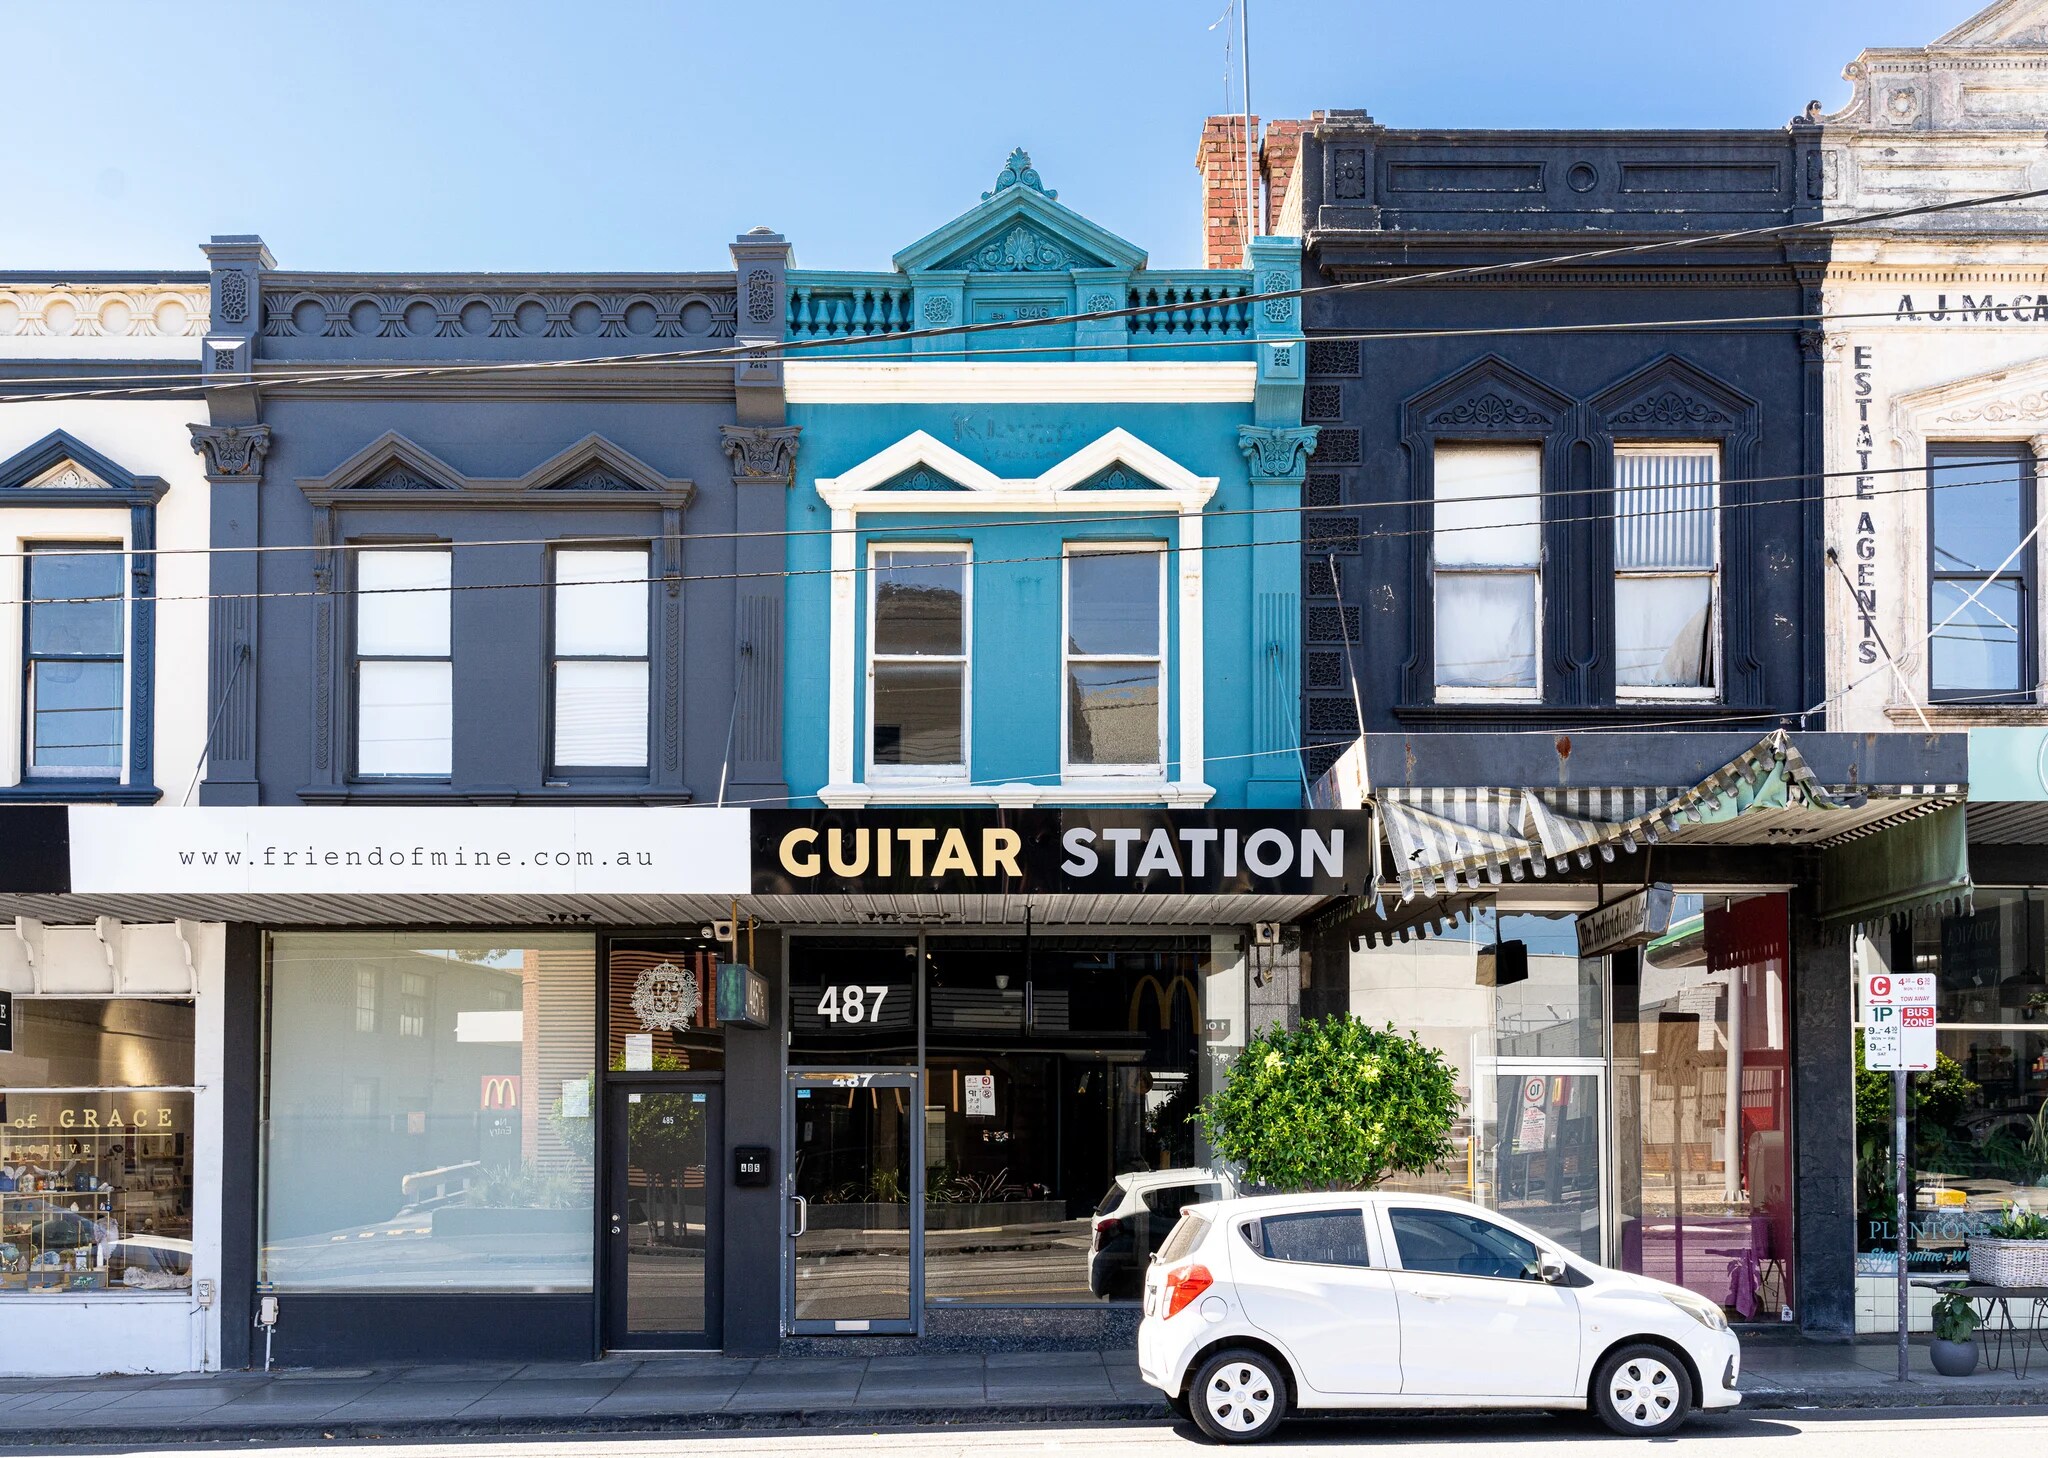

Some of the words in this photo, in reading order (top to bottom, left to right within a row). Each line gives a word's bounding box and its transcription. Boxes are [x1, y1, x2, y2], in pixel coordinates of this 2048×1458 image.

[1014, 306, 1049, 319] 1946
[1896, 294, 1921, 322] A.
[1929, 294, 1950, 322] J.
[1854, 346, 1875, 500] ESTATE
[1856, 511, 1877, 664] AGENTS
[179, 846, 653, 866] www.friendofmine.com.au
[779, 828, 1023, 878] GUITAR
[1061, 827, 1344, 878] STATION
[817, 984, 889, 1023] 487
[1872, 1007, 1893, 1022] 1P
[1907, 1008, 1929, 1017] BUS
[1903, 1018, 1934, 1026] ZONE
[14, 1113, 37, 1129] of
[60, 1108, 172, 1128] GRACE
[662, 1116, 674, 1125] 485
[15, 1144, 91, 1154] ECTIVE
[741, 1163, 760, 1172] 485
